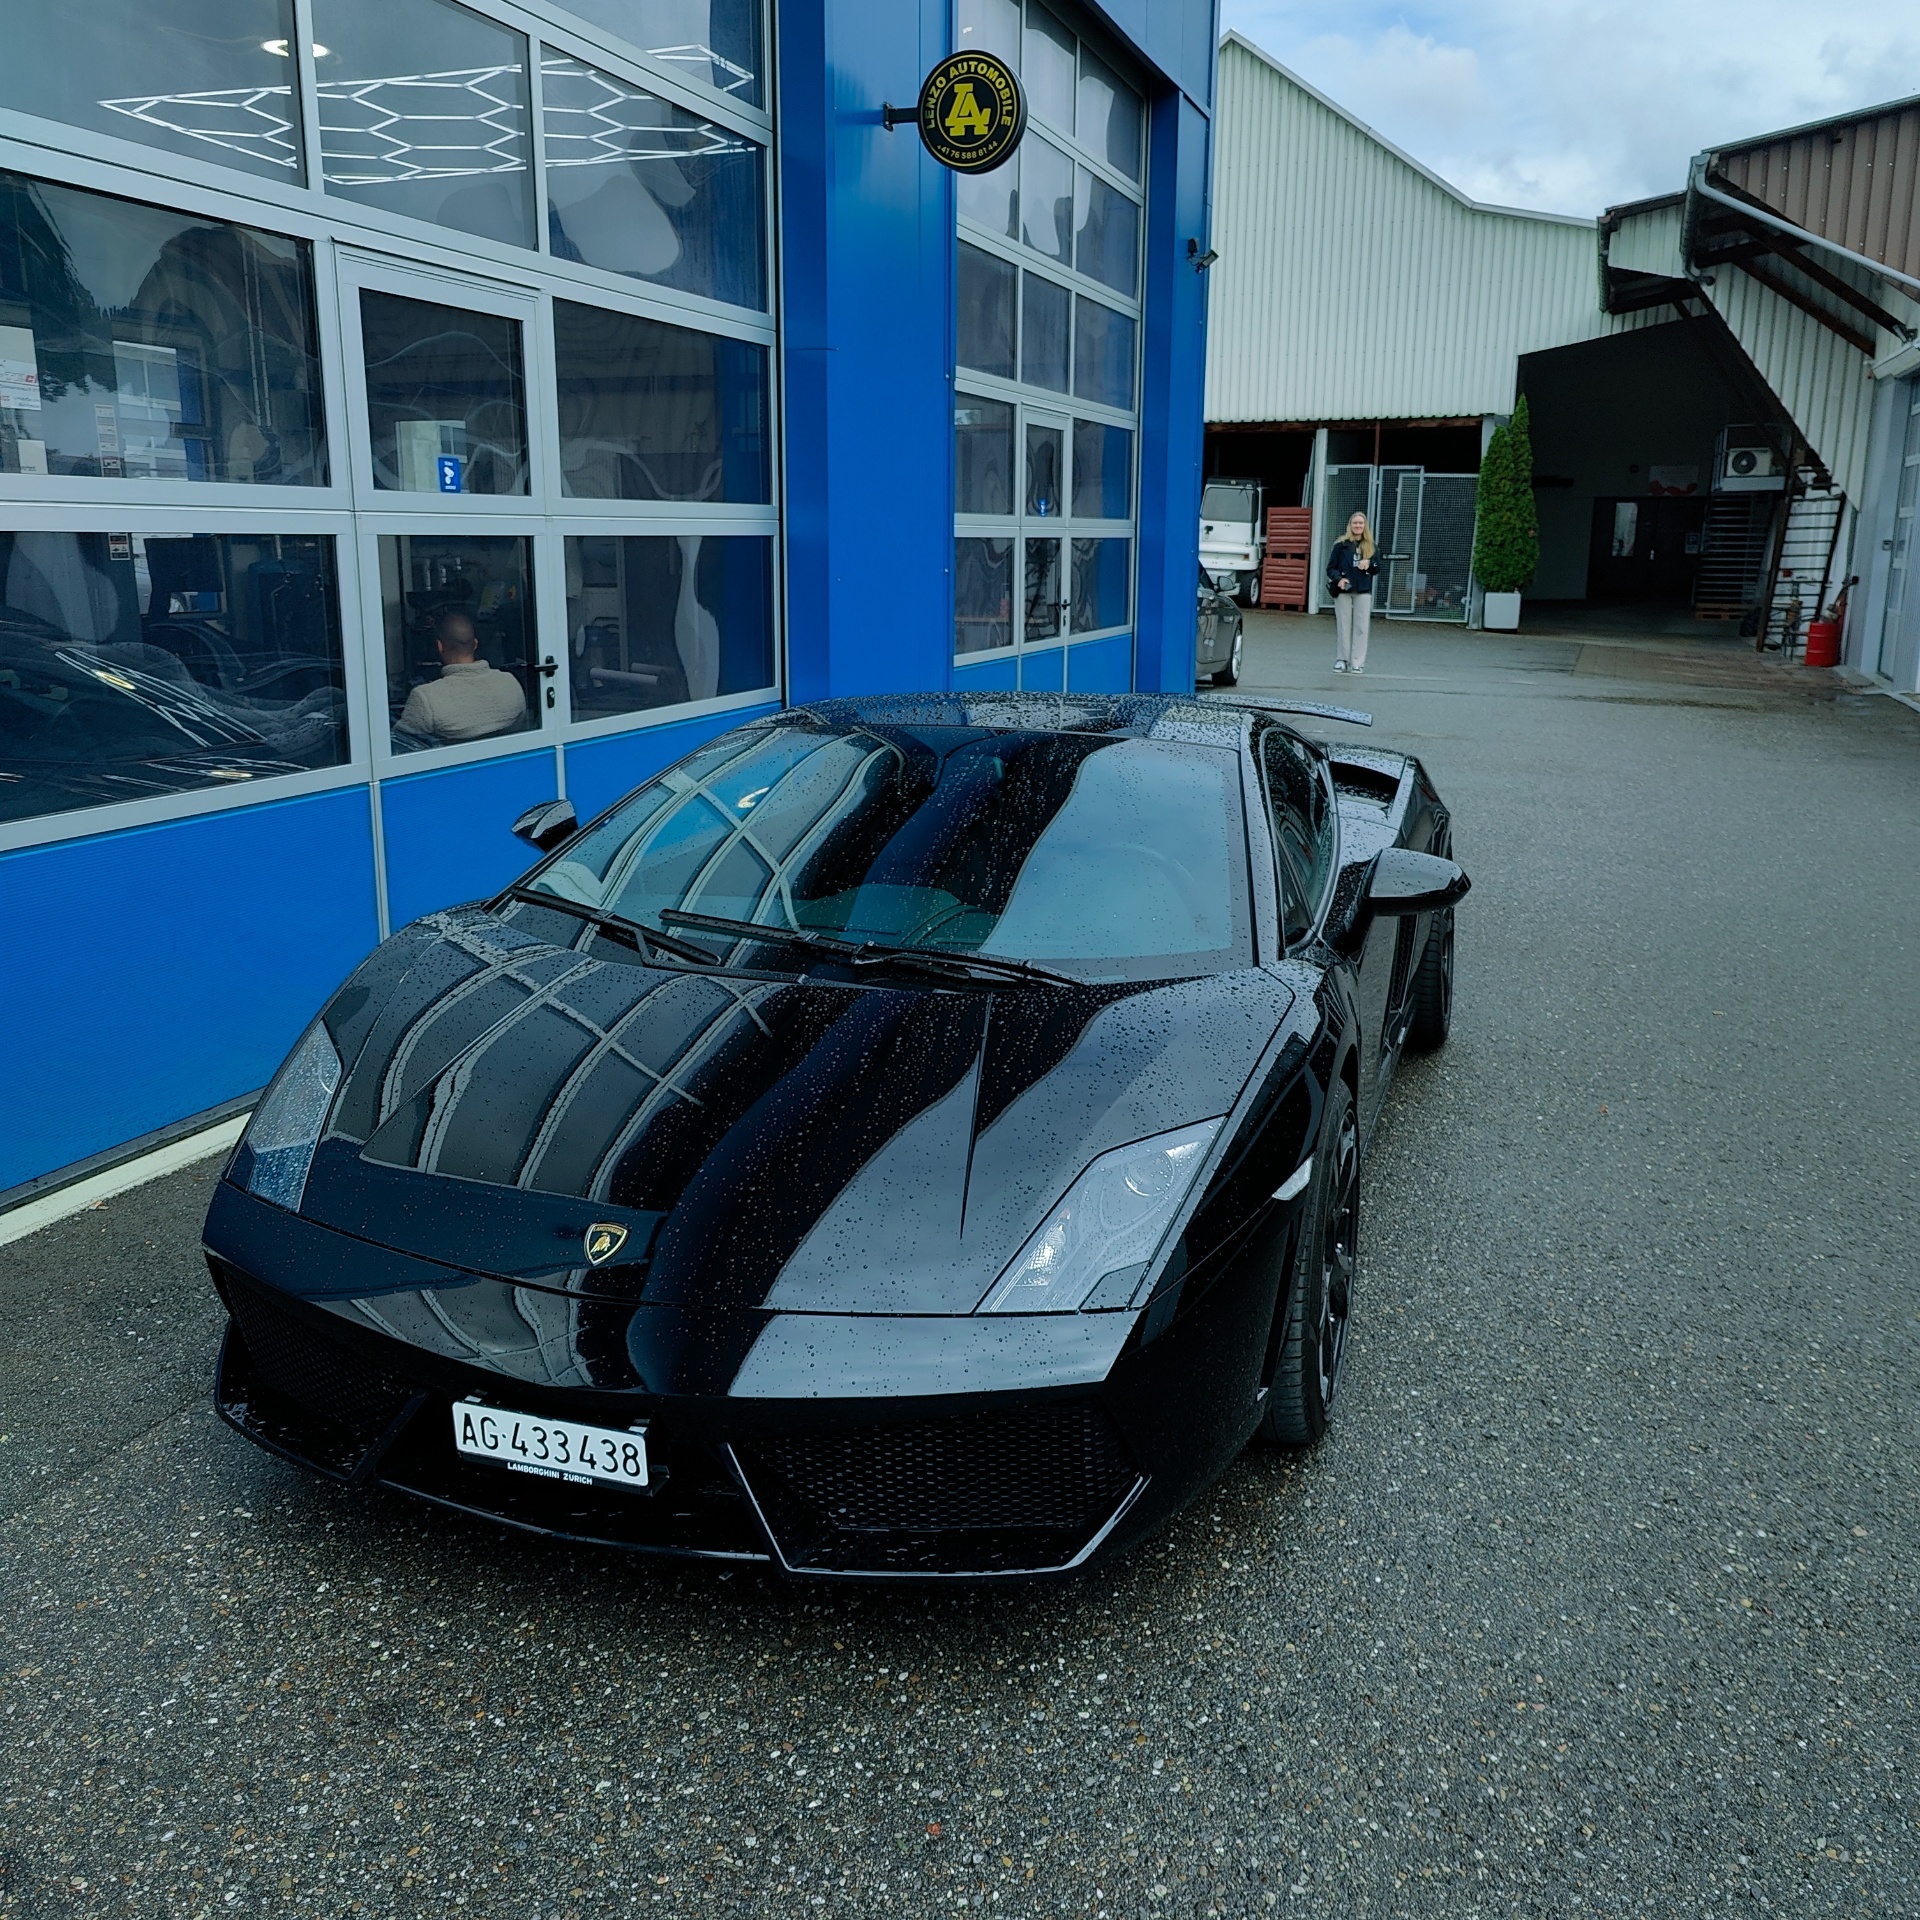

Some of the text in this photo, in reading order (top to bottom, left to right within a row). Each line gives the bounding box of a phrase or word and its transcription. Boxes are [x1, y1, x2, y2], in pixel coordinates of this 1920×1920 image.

[925, 61, 1013, 130] LENZO AUTOMOBILE
[951, 150, 960, 159] 76
[507, 1462, 593, 1485] LAMBORGHINI ZURICH
